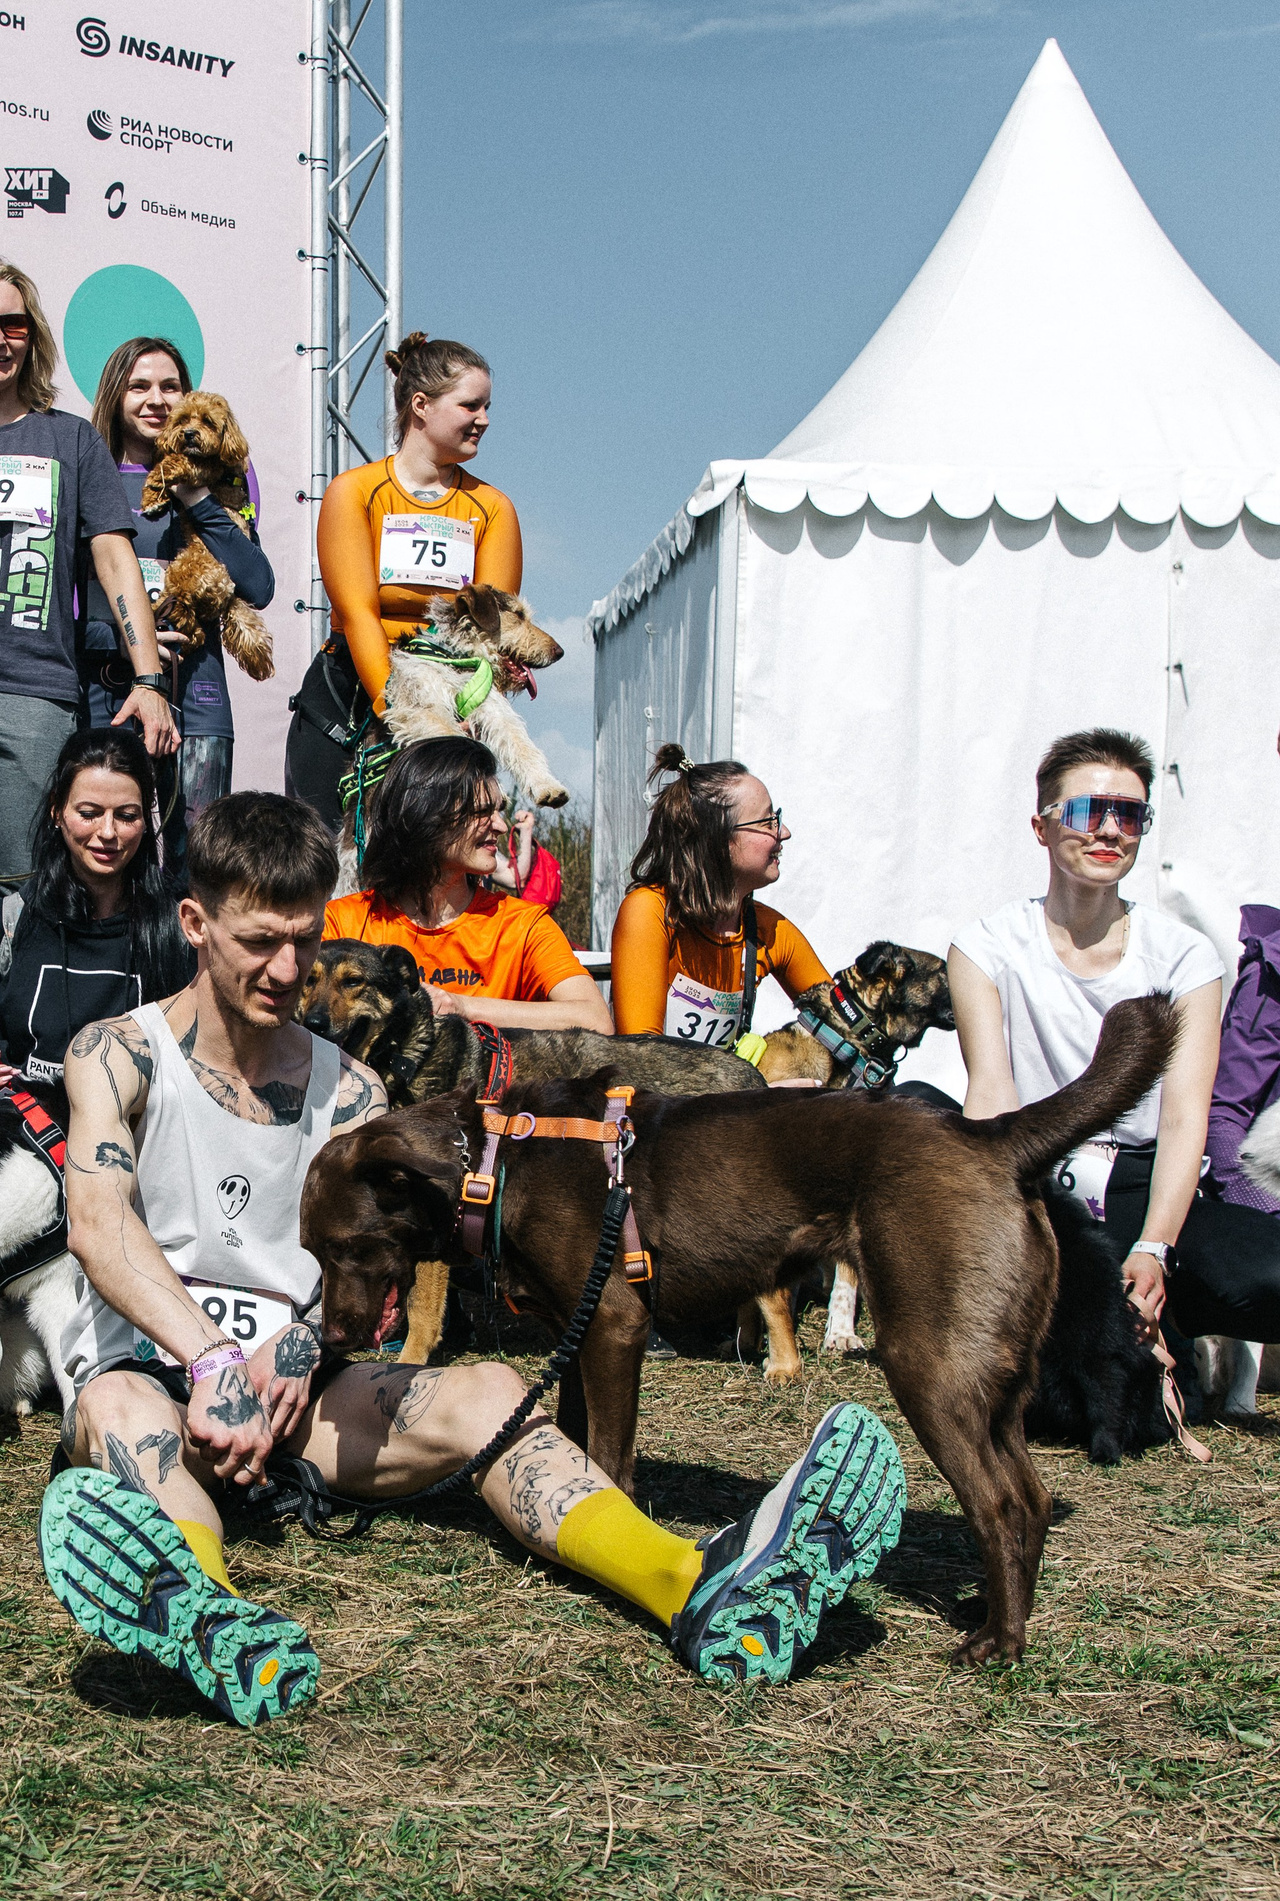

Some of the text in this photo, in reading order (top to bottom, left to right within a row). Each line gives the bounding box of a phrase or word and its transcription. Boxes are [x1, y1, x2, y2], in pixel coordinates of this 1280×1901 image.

[118, 34, 235, 78] INSANITY
[120, 116, 233, 152] РИА НОВОСТИ
[120, 131, 173, 154] СПОРТ
[6, 169, 54, 191] ХИТ
[141, 199, 236, 230] Объём медиа
[412, 539, 447, 568] 75
[677, 1011, 736, 1046] 312
